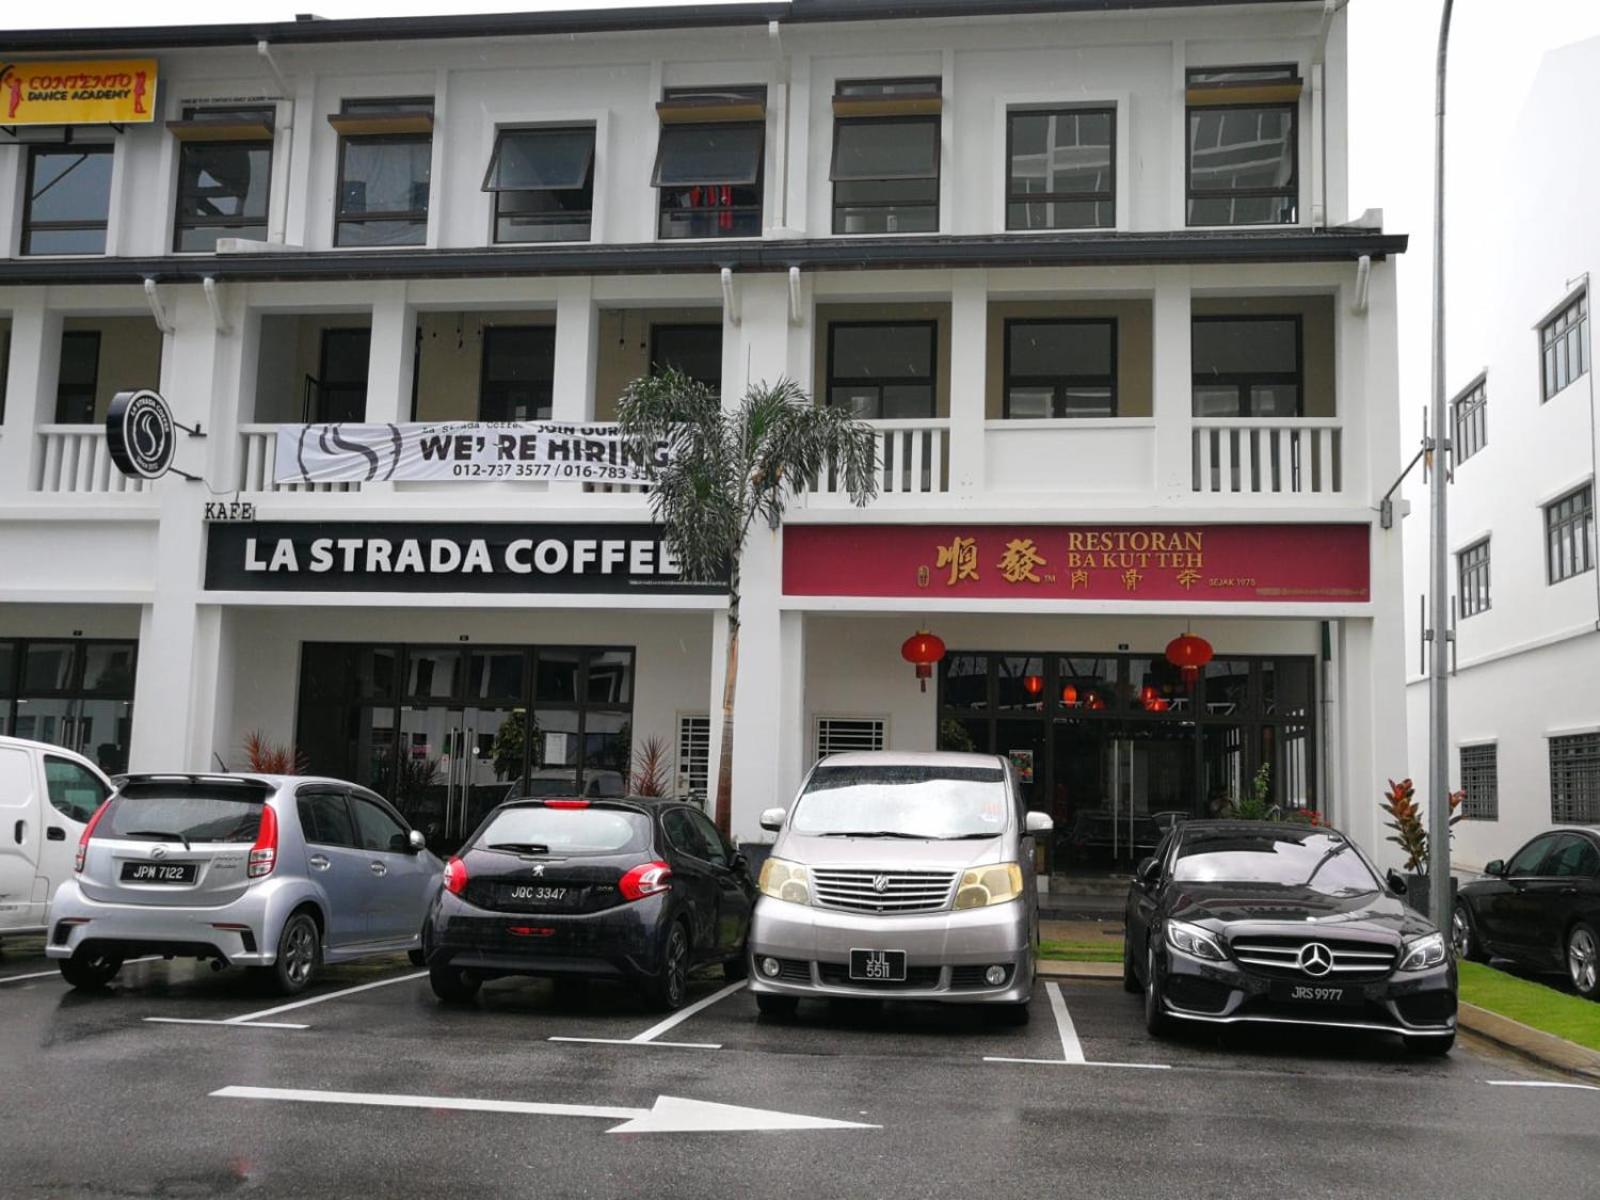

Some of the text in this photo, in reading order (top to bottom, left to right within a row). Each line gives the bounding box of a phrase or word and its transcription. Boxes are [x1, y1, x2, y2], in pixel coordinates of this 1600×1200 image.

[29, 73, 132, 90] CONTENTO
[28, 90, 131, 102] DANCE ACADEMY
[548, 439, 670, 467] HIRING
[453, 464, 511, 476] 012-737
[515, 464, 551, 476] 3577
[564, 465, 627, 479] 016-783
[205, 503, 252, 520] KAFE
[1068, 532, 1203, 551] RESTORAN
[245, 538, 682, 574] LA STRADA COFFEE
[1068, 553, 1203, 568] BA KUT TEH
[159, 867, 184, 879] 7122
[511, 886, 566, 900] JQC 3347
[866, 951, 890, 965] JJL
[866, 964, 890, 978] 5511
[1291, 986, 1343, 1000] JRS 9977
